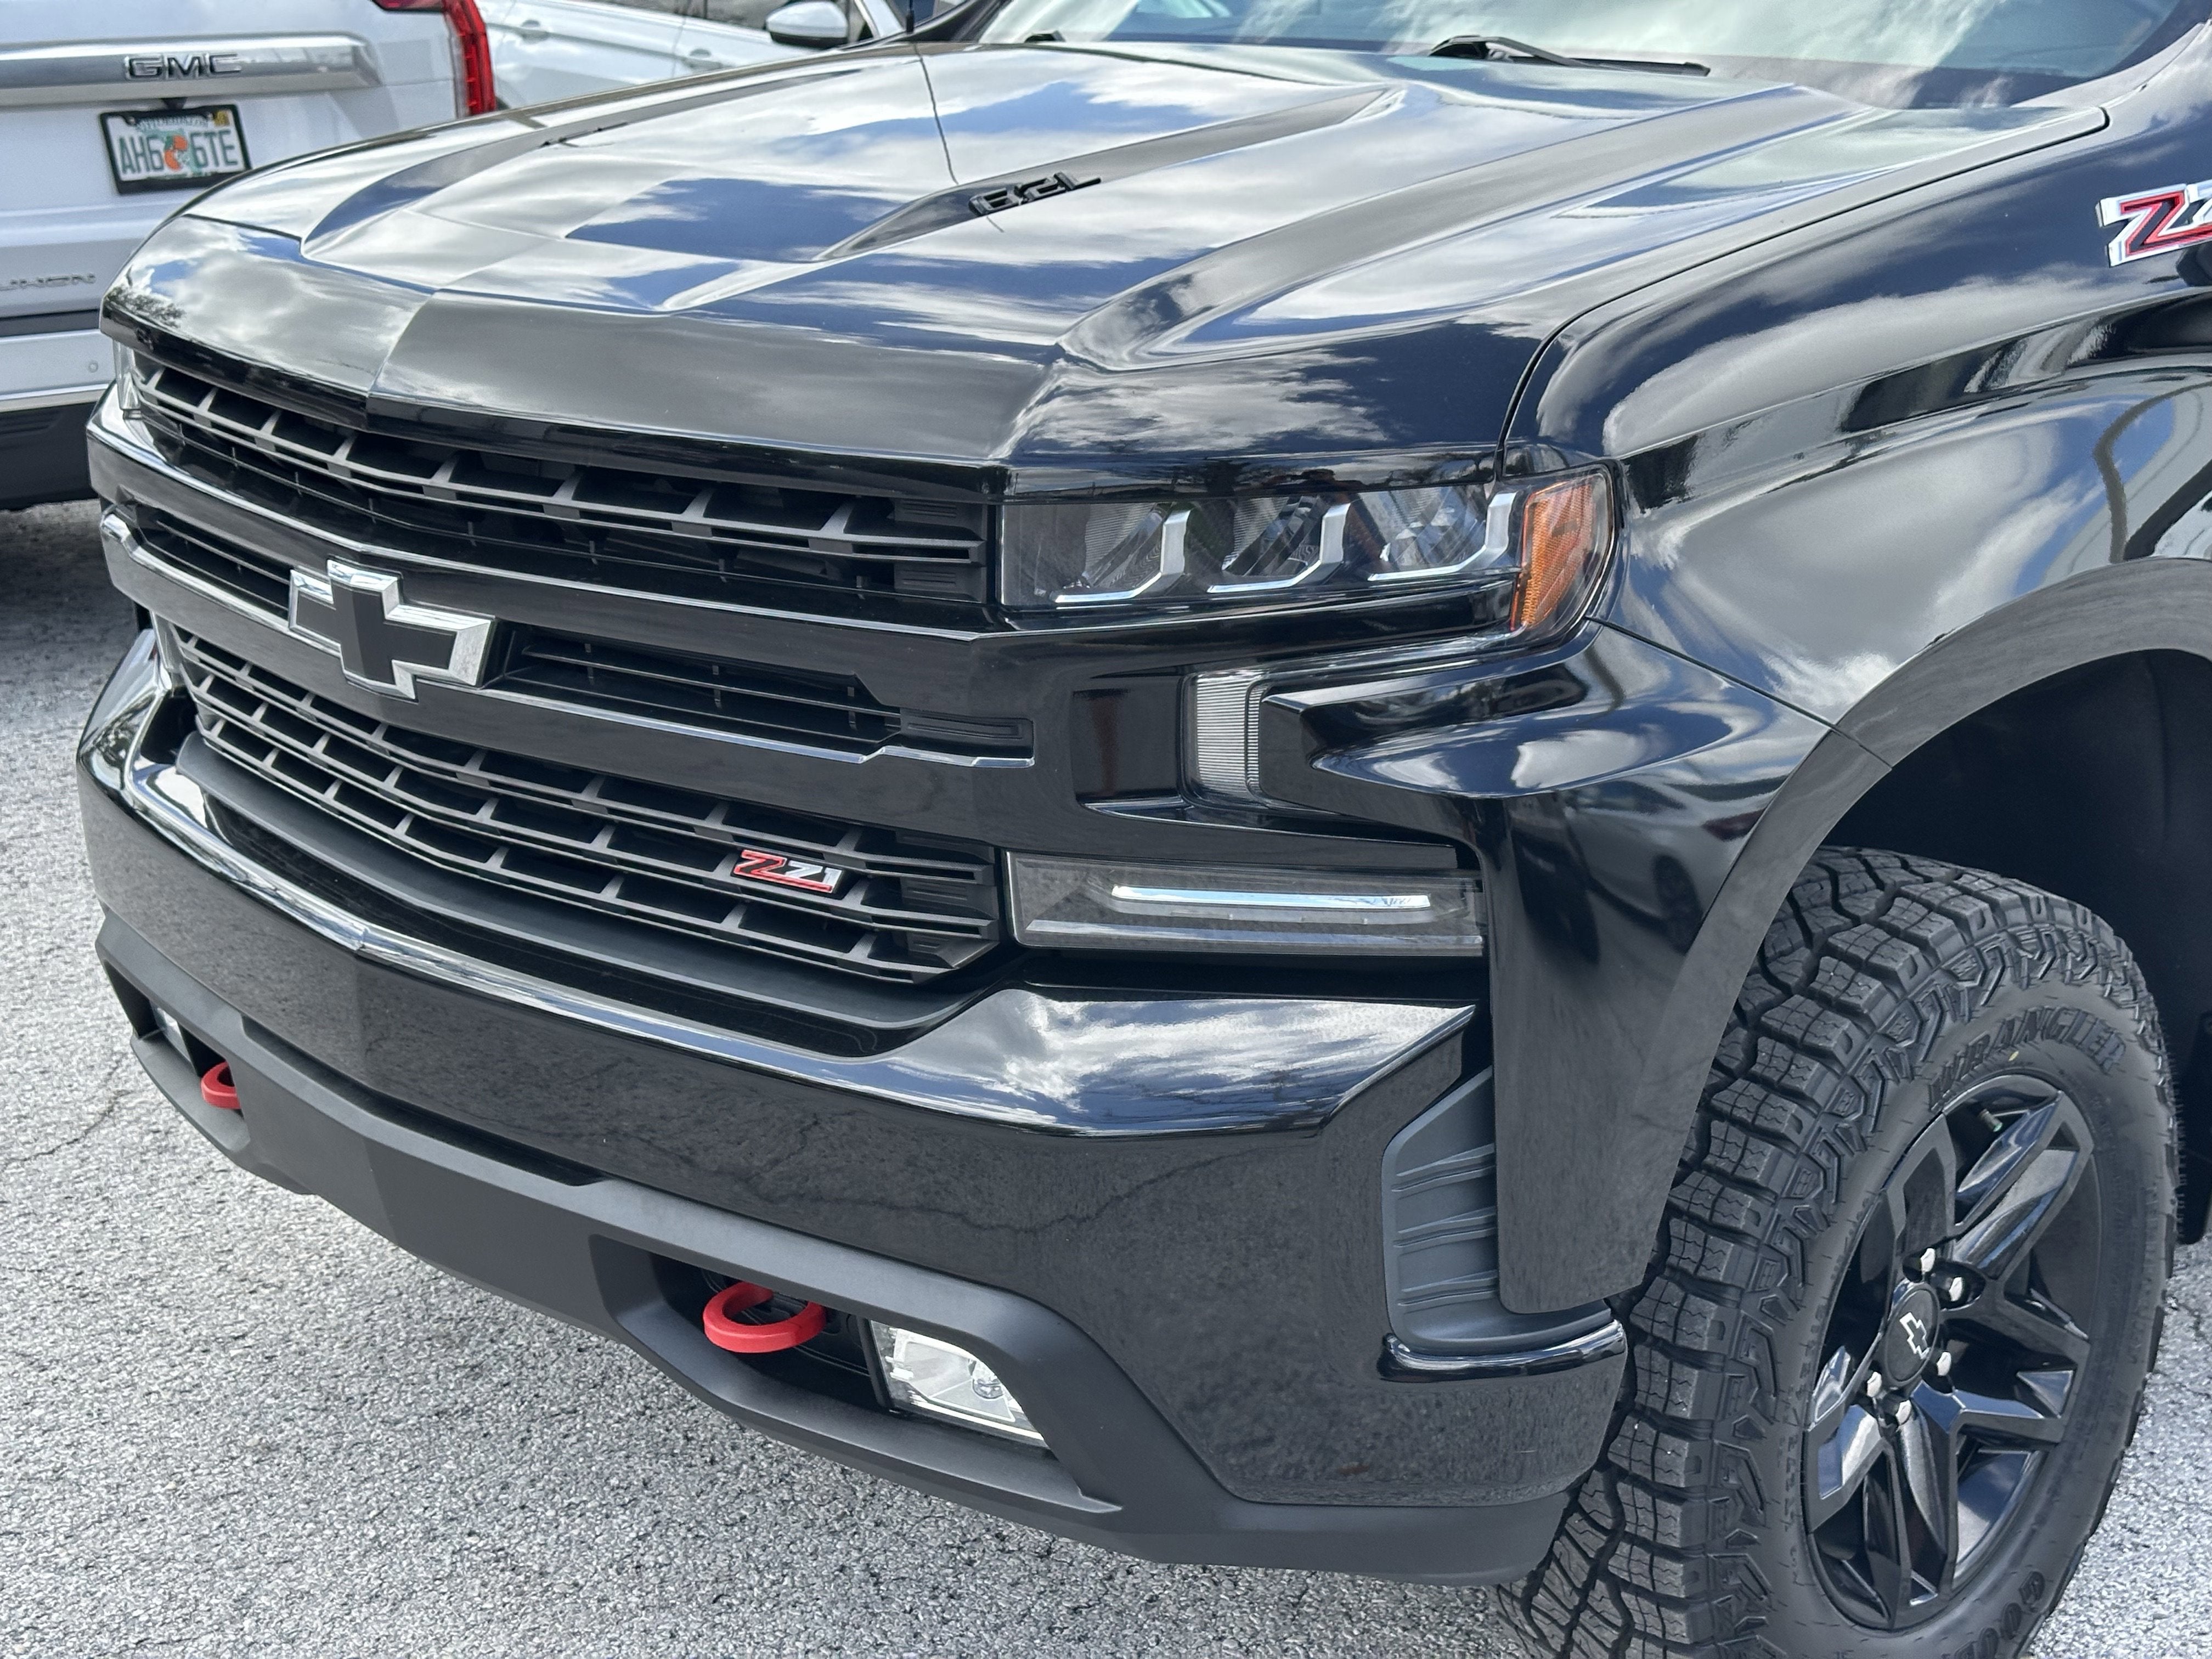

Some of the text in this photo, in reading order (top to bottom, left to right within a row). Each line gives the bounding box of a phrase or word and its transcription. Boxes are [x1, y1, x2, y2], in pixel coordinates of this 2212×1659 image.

[124, 53, 242, 81] GMC
[733, 849, 843, 894] Z71
[1928, 1005, 2126, 1111] WRANGLER
